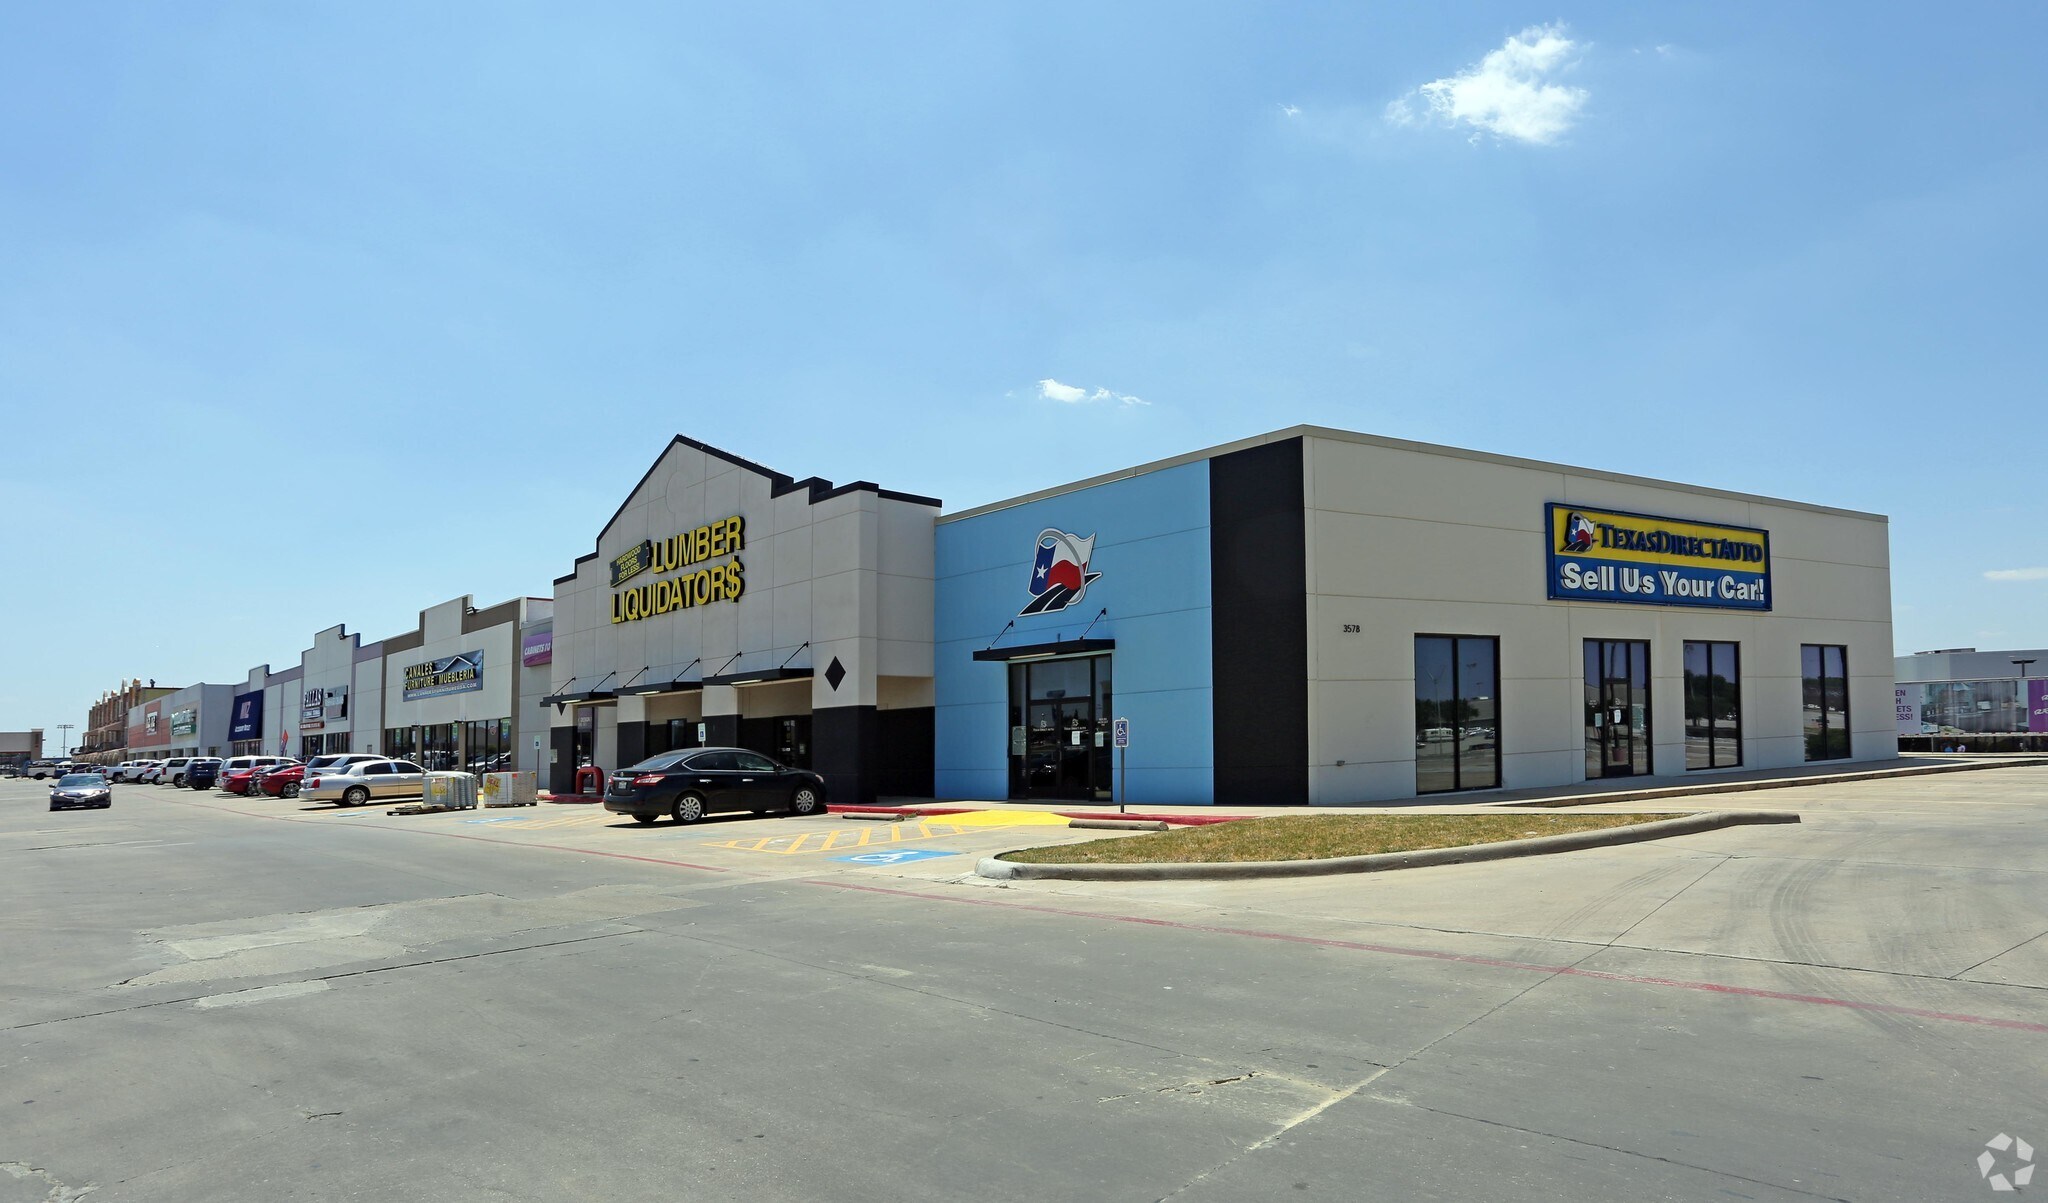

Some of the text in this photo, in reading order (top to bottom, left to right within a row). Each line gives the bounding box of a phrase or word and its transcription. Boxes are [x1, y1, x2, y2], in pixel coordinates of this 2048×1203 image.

[653, 515, 742, 574] LUMBER
[616, 545, 641, 566] HARDWOOD
[620, 556, 638, 571] FLOORS
[618, 571, 628, 582] FOR
[1560, 562, 1765, 601] Sell Us Your Car!
[611, 555, 742, 624] LIQUIDATOR$
[1343, 624, 1361, 633] 3578
[404, 668, 475, 690] FURNITURE MUEBLERIA
[405, 662, 433, 680] CANALES
